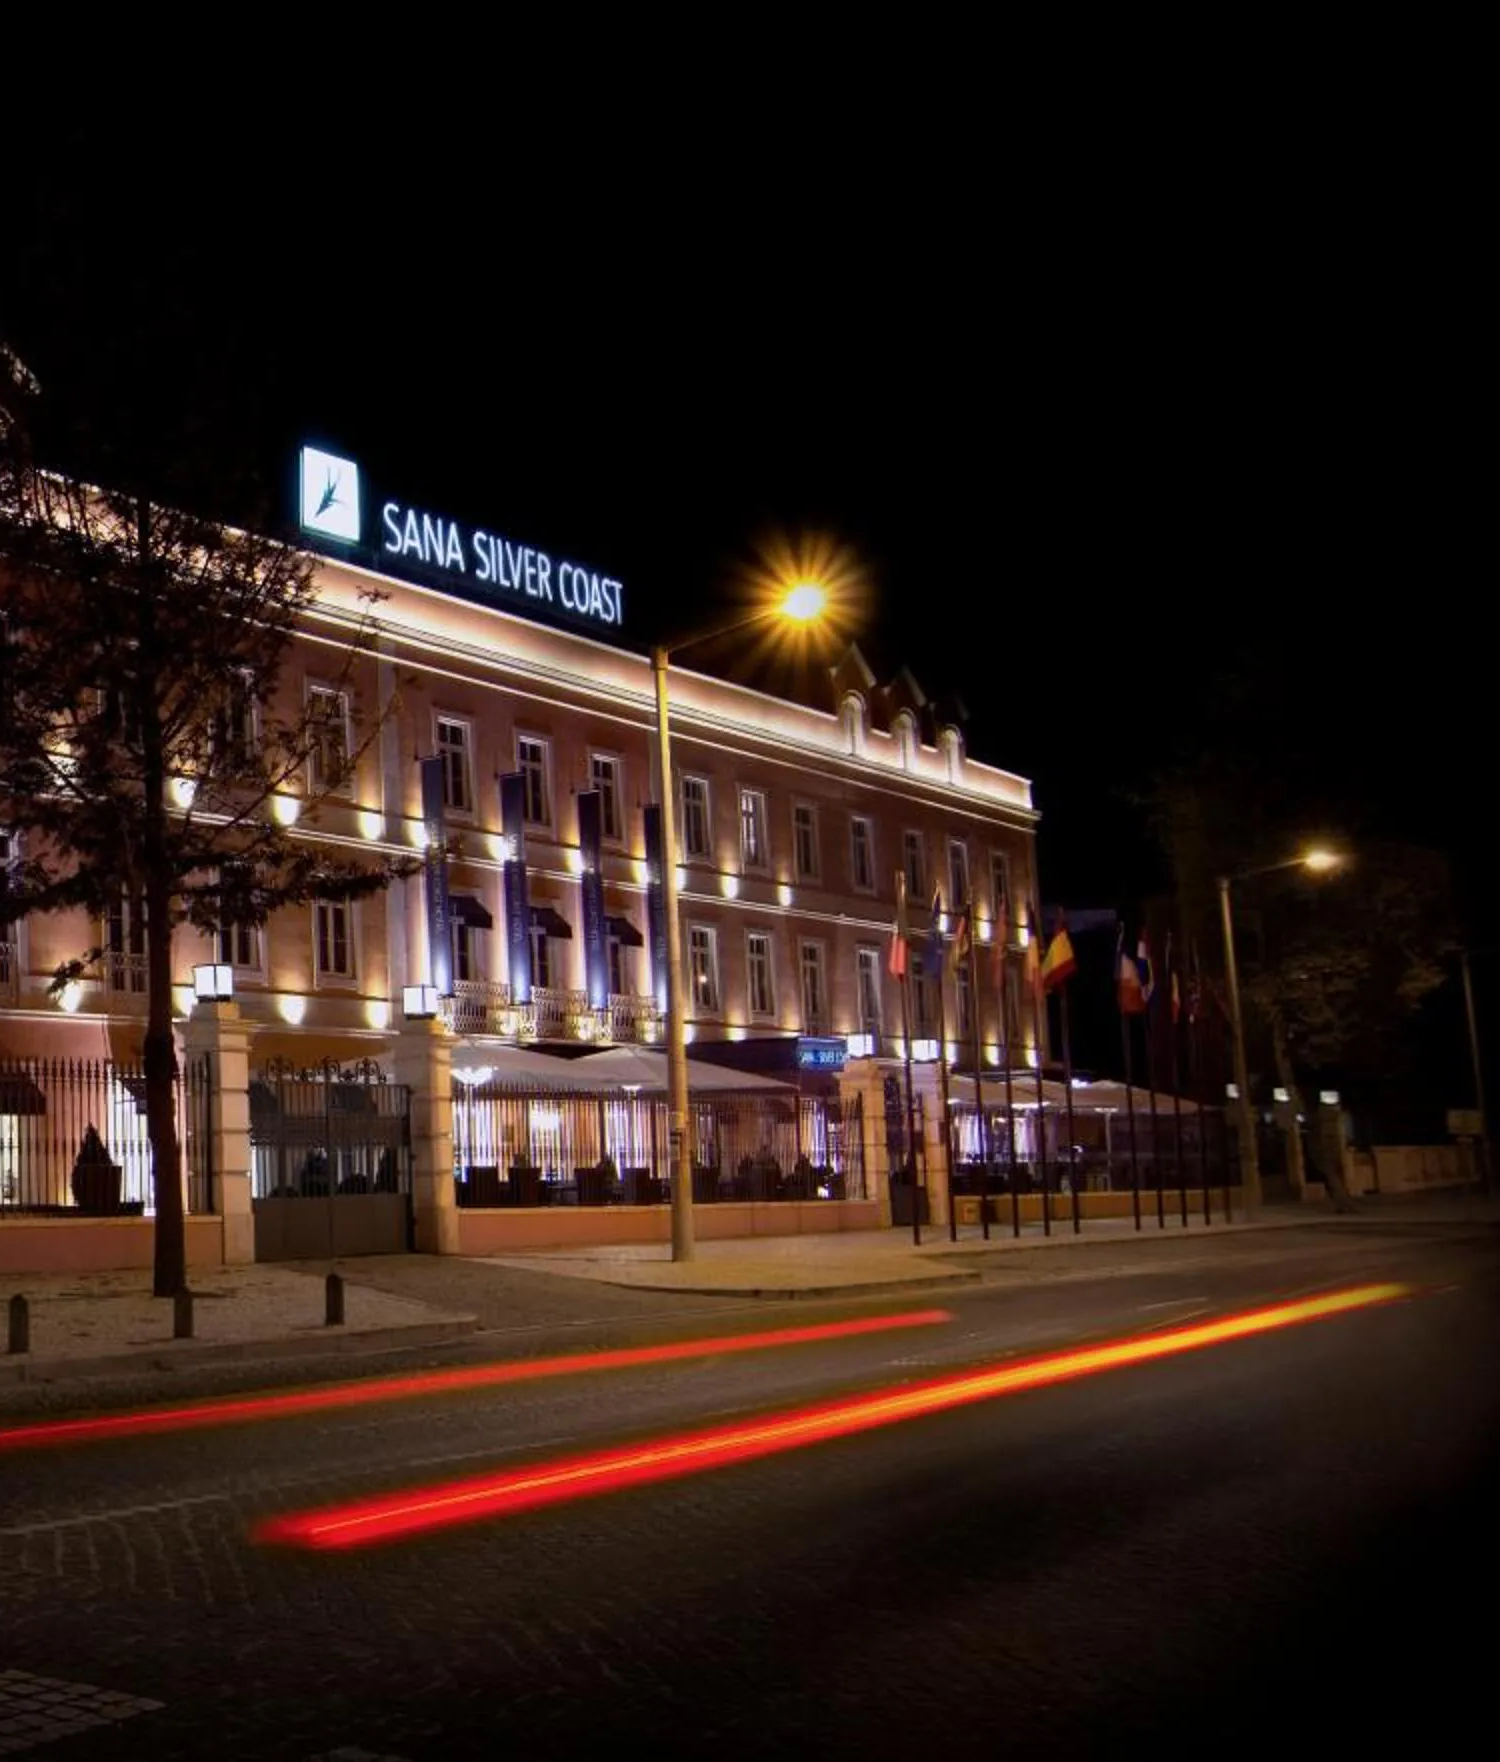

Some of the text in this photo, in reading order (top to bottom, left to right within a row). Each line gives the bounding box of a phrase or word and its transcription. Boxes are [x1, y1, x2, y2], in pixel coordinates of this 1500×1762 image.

[383, 502, 623, 625] SANA SILVER COAST
